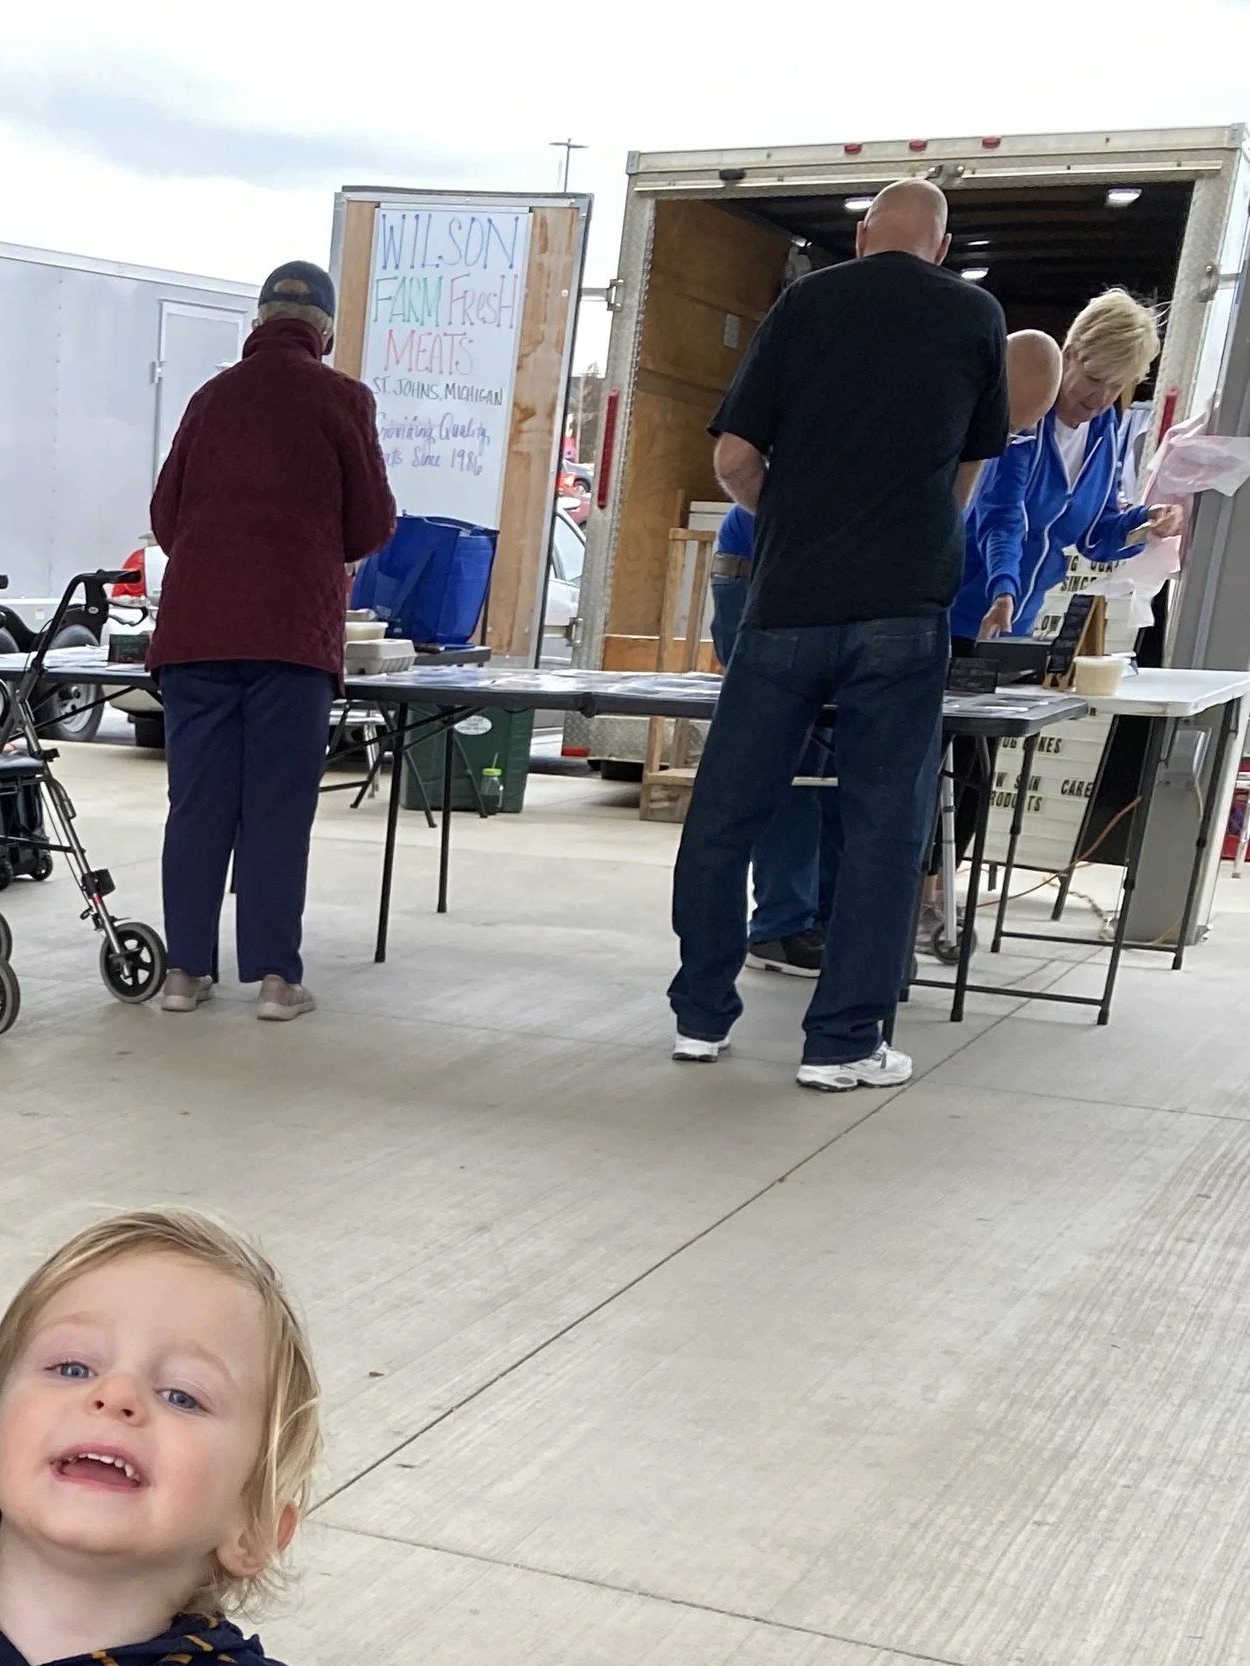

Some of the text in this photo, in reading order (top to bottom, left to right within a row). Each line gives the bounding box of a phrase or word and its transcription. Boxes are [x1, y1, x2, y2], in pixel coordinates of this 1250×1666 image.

[381, 213, 519, 270] WILSON
[373, 275, 443, 328] FARM
[382, 328, 474, 376] MEATS
[444, 382, 503, 406] MICHIGAN
[1035, 615, 1062, 631] OW
[1014, 773, 1042, 792] SIN
[1060, 779, 1095, 798] CARE
[990, 790, 1043, 812] RODUTS
